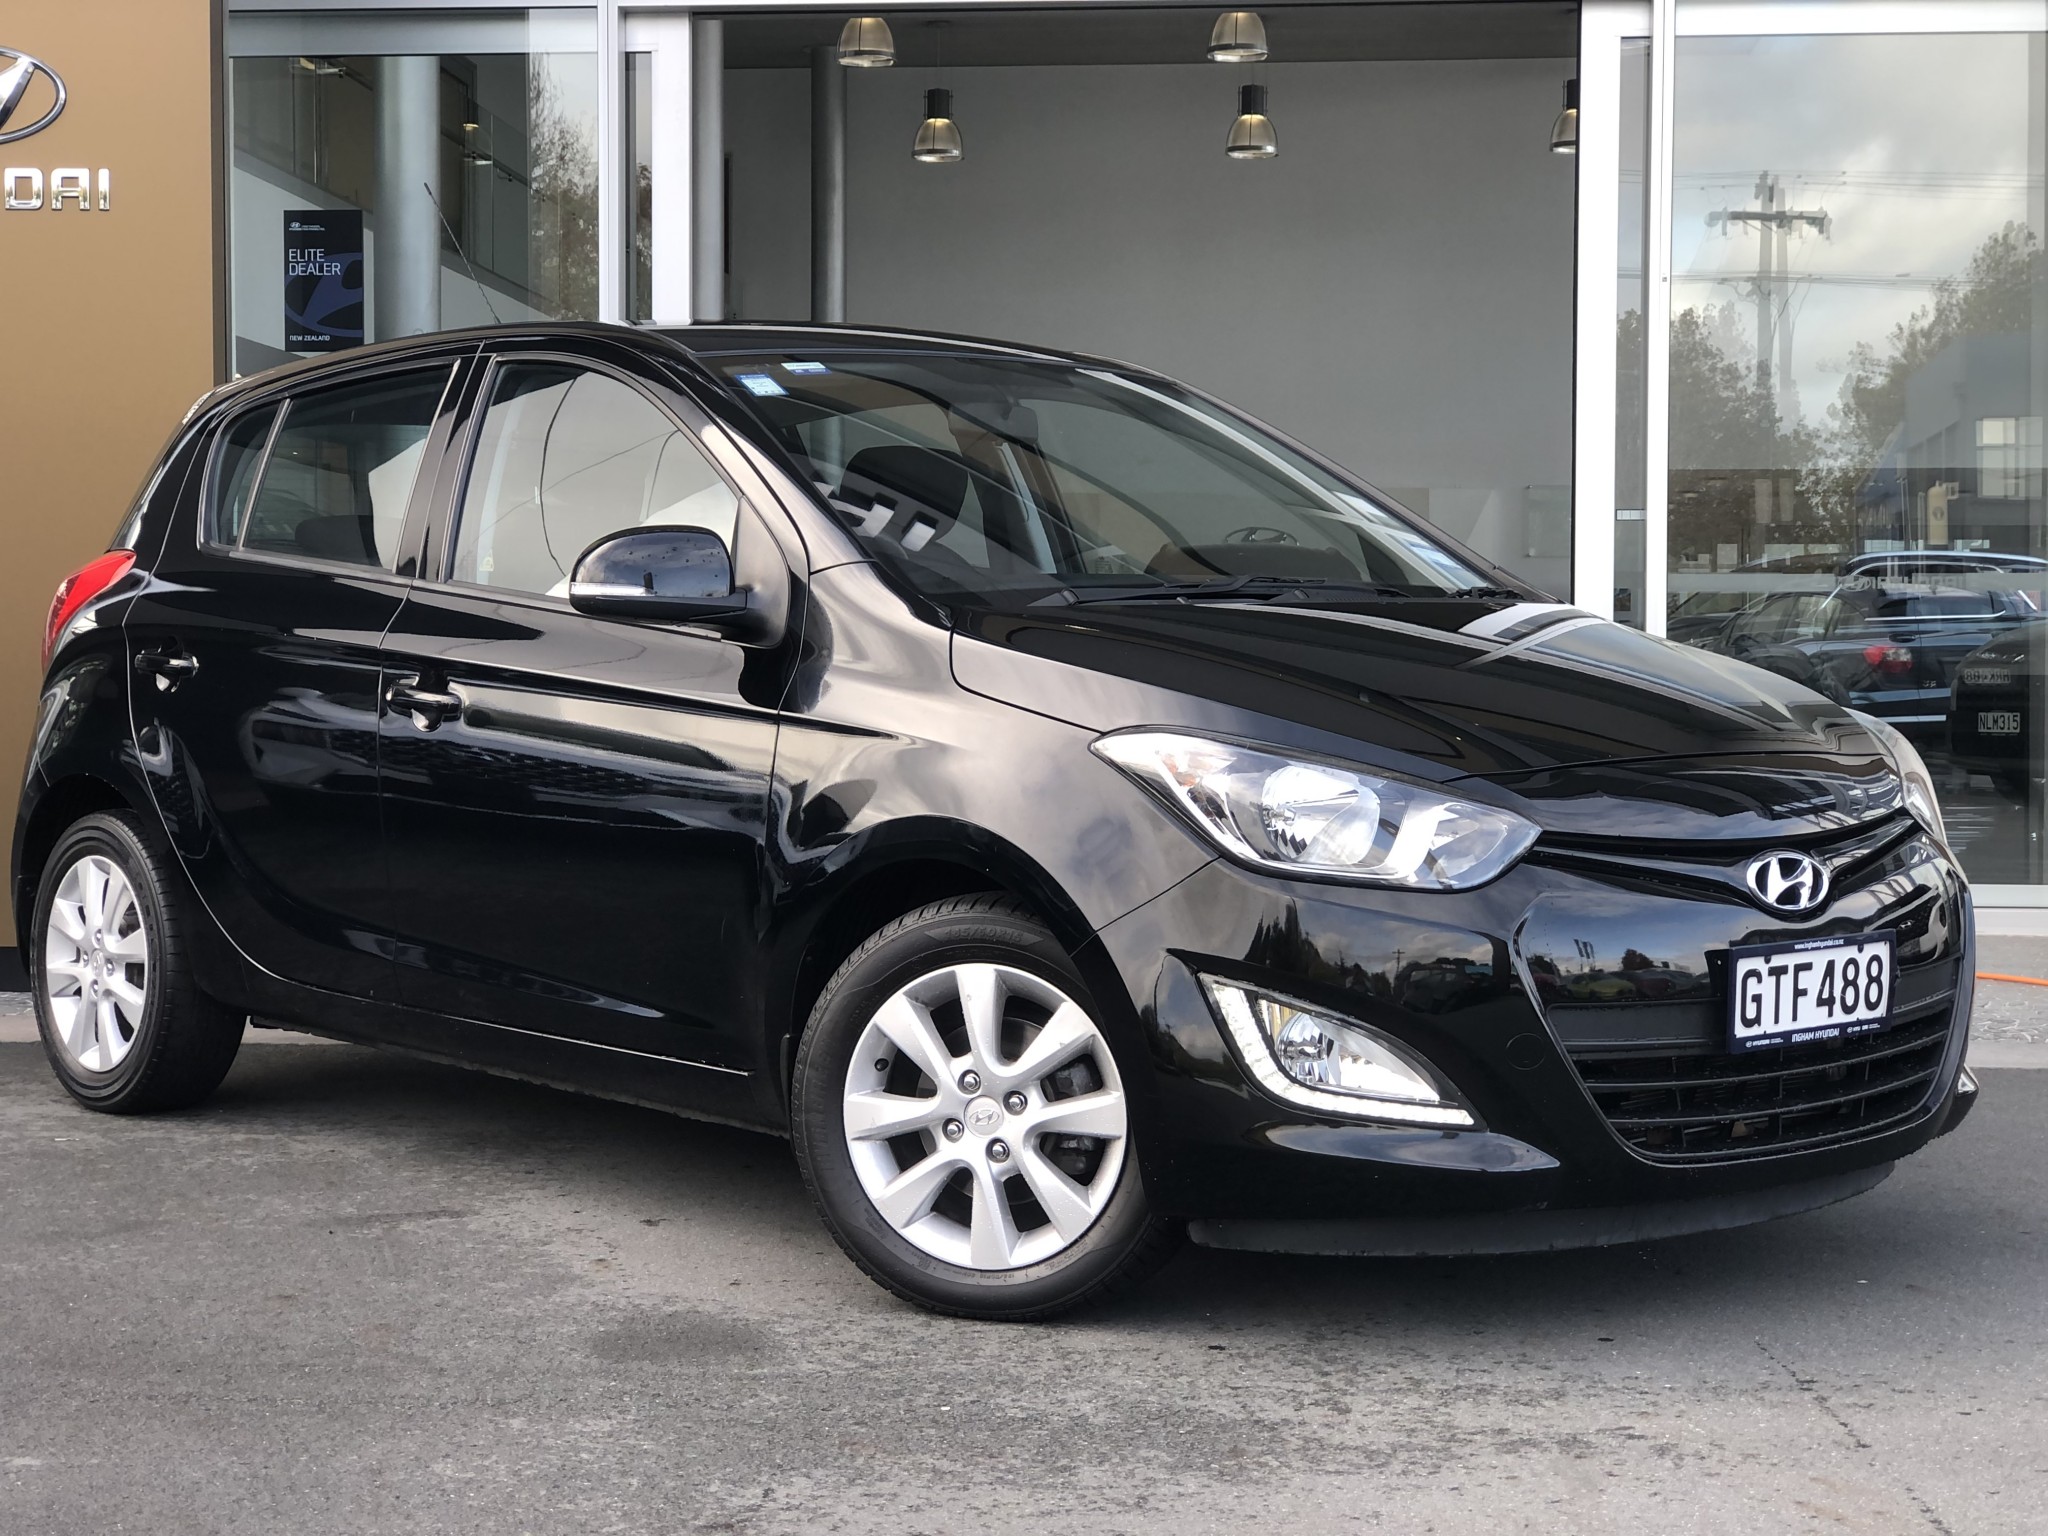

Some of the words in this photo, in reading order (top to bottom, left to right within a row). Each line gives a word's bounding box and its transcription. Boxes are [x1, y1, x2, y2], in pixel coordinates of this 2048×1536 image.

[4, 168, 110, 211] DAI
[288, 248, 325, 261] ELITE
[288, 262, 341, 276] DEALER
[1979, 714, 2019, 730] NLM315
[1740, 954, 1884, 1028] GTF488
[1791, 1032, 1814, 1043] INGHAM
[1814, 1028, 1840, 1041] HYUNDAI
